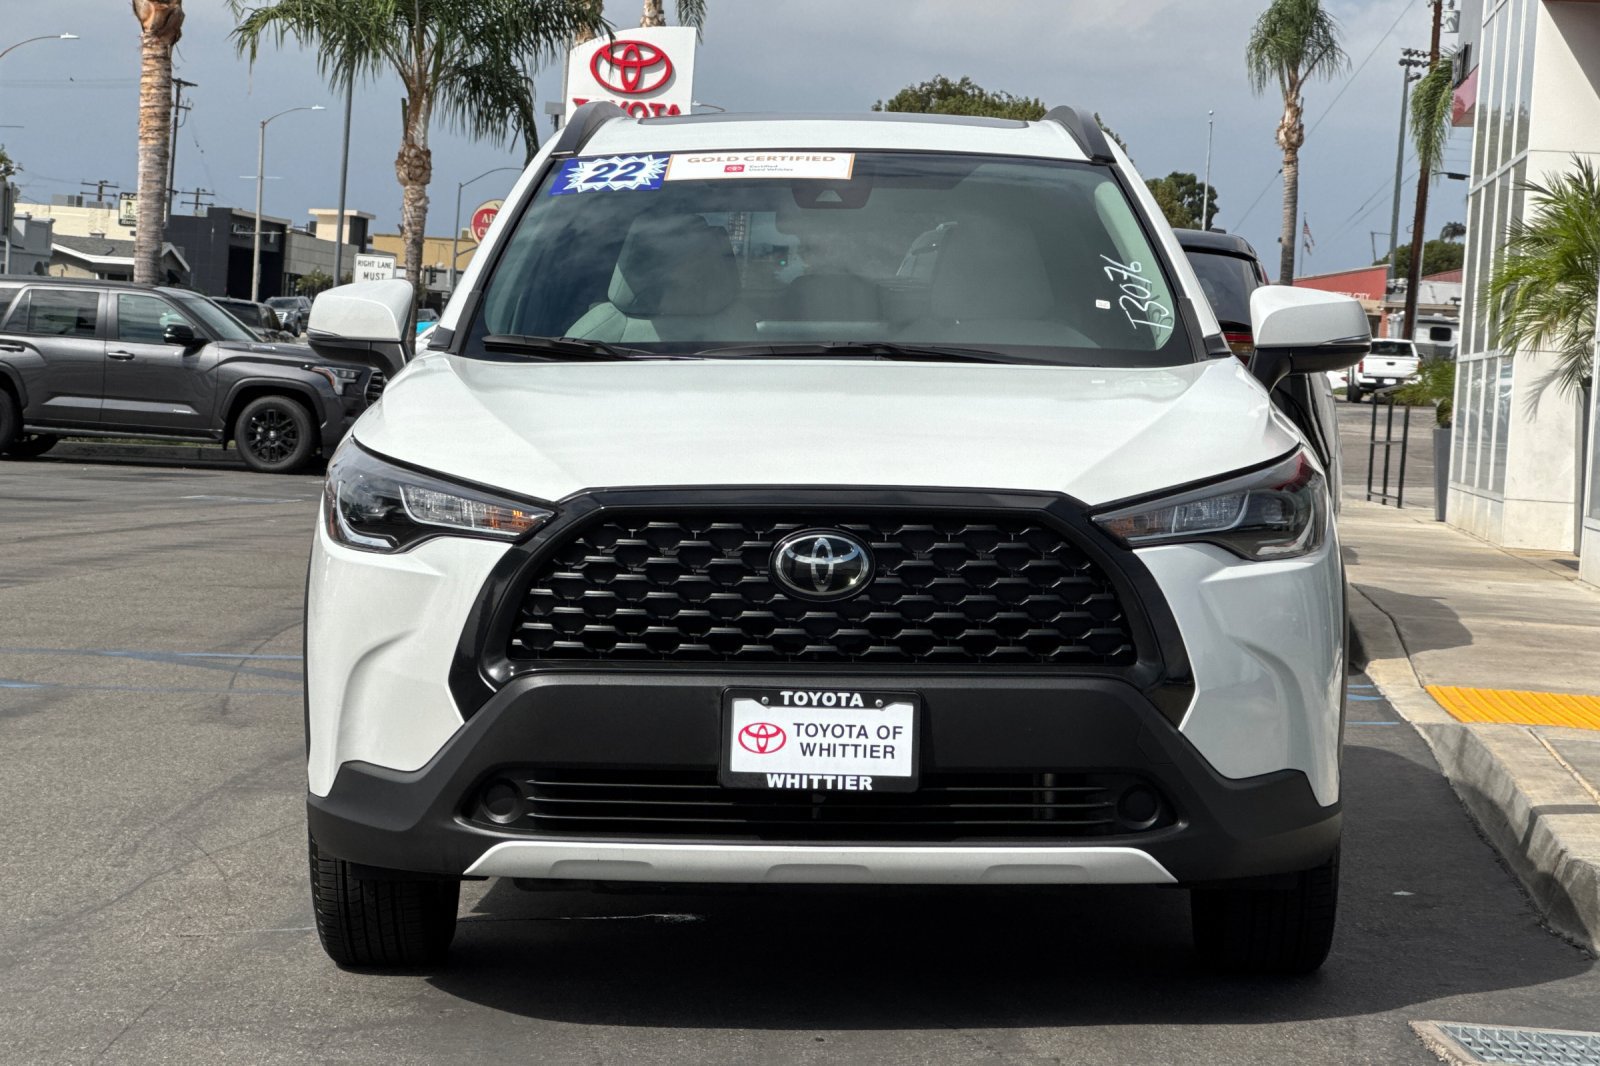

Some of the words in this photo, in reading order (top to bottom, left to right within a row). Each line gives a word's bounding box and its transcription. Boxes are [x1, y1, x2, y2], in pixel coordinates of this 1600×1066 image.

[573, 98, 681, 118] OTA
[582, 161, 647, 183] 22
[357, 260, 375, 268] RIGHT
[377, 260, 392, 269] LANE
[363, 272, 385, 280] MUST
[780, 691, 864, 707] TOYOTA
[793, 722, 869, 739] TOYOTA
[876, 725, 903, 740] OF
[799, 742, 895, 759] WHITTIER
[766, 773, 872, 791] WHITTIER
